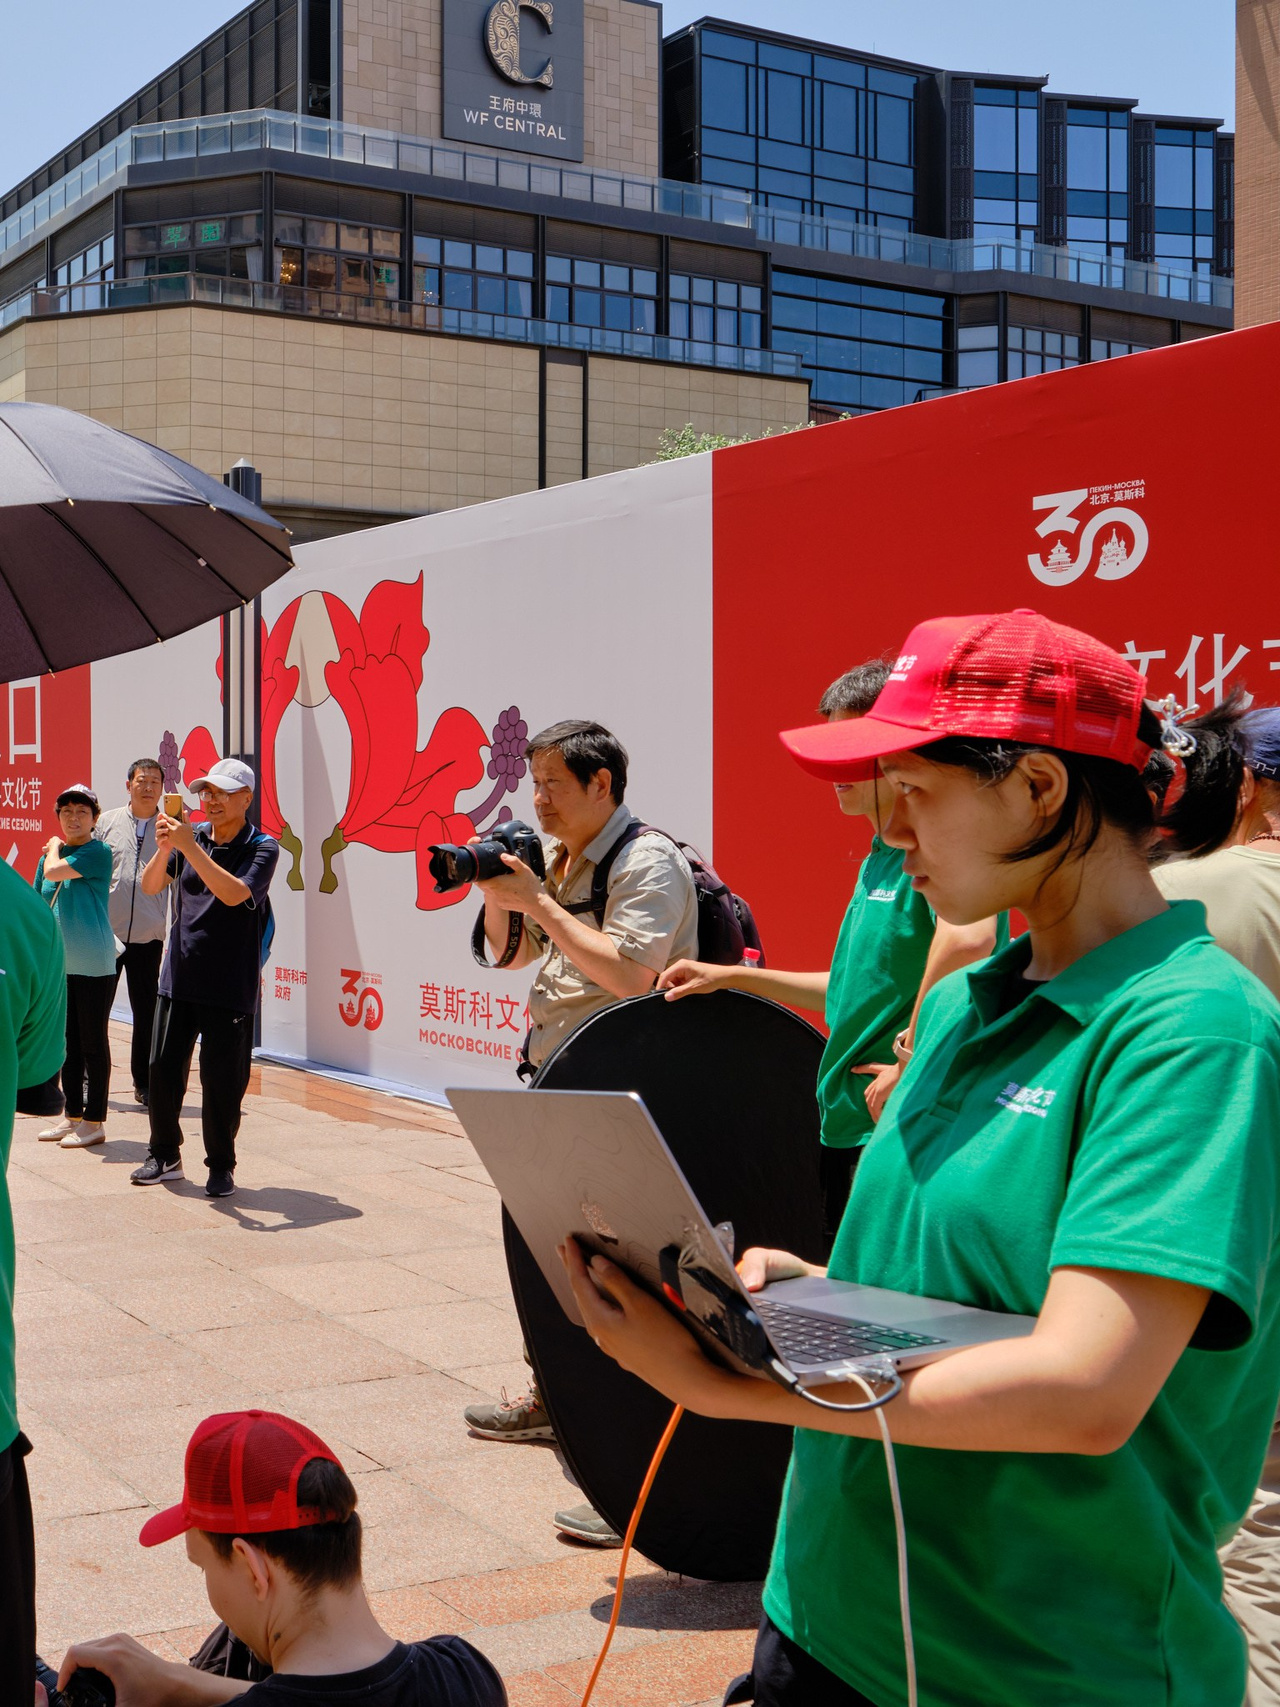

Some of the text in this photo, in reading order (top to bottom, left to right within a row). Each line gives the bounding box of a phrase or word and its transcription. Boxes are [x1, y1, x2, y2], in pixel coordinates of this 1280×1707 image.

[488, 94, 542, 119] 王府中環
[463, 108, 567, 140] WF CENTRAL
[1089, 478, 1146, 494] ПЕКИН-МОСКВА
[1089, 486, 1146, 506] 北京-莫斯科
[11, 818, 43, 832] СЕЗОНЫ
[274, 966, 308, 986] 莫斯科市
[274, 984, 292, 1001] 政府
[419, 1028, 512, 1061] МОСКОВСКИЕ
